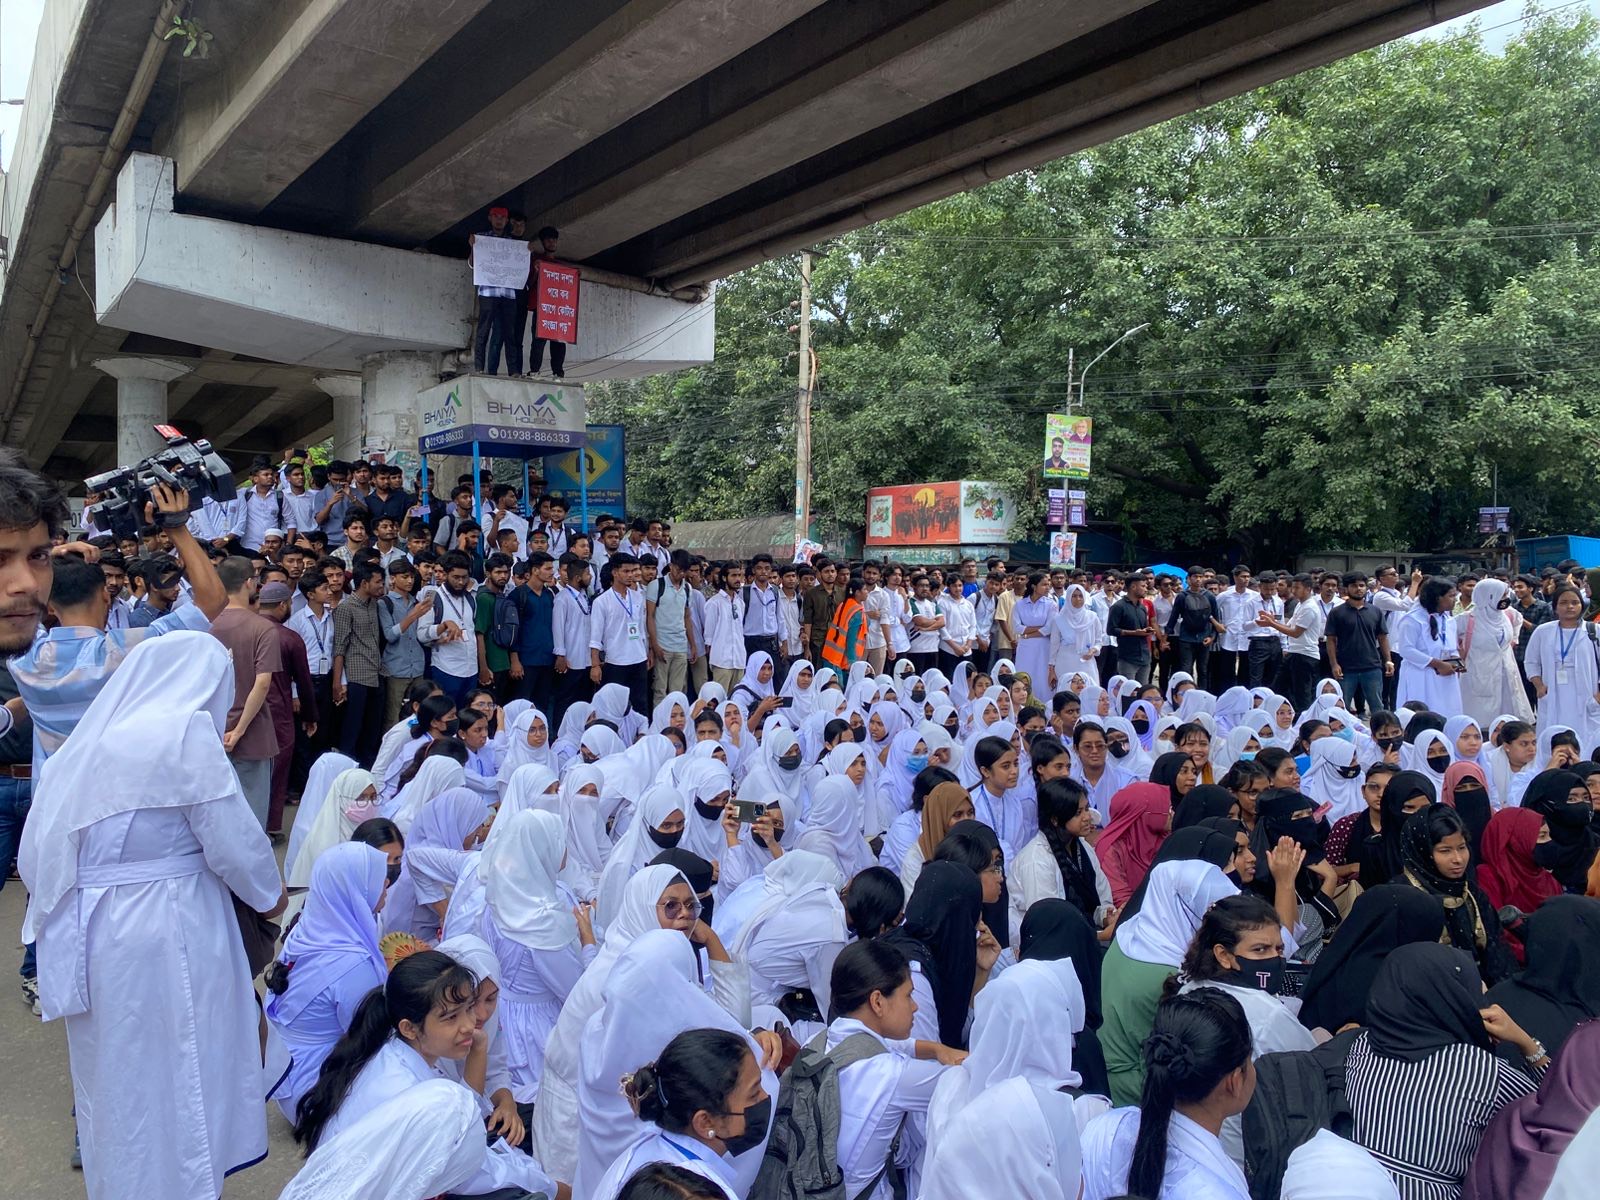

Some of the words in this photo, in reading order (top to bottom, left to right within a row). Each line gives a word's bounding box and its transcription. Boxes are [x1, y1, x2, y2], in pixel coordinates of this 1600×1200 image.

[424, 405, 456, 424] BHAIYA
[487, 401, 556, 419] BHAIYA
[515, 416, 557, 426] HOUSING
[500, 430, 570, 444] 01938-886333
[1256, 971, 1271, 988] T
